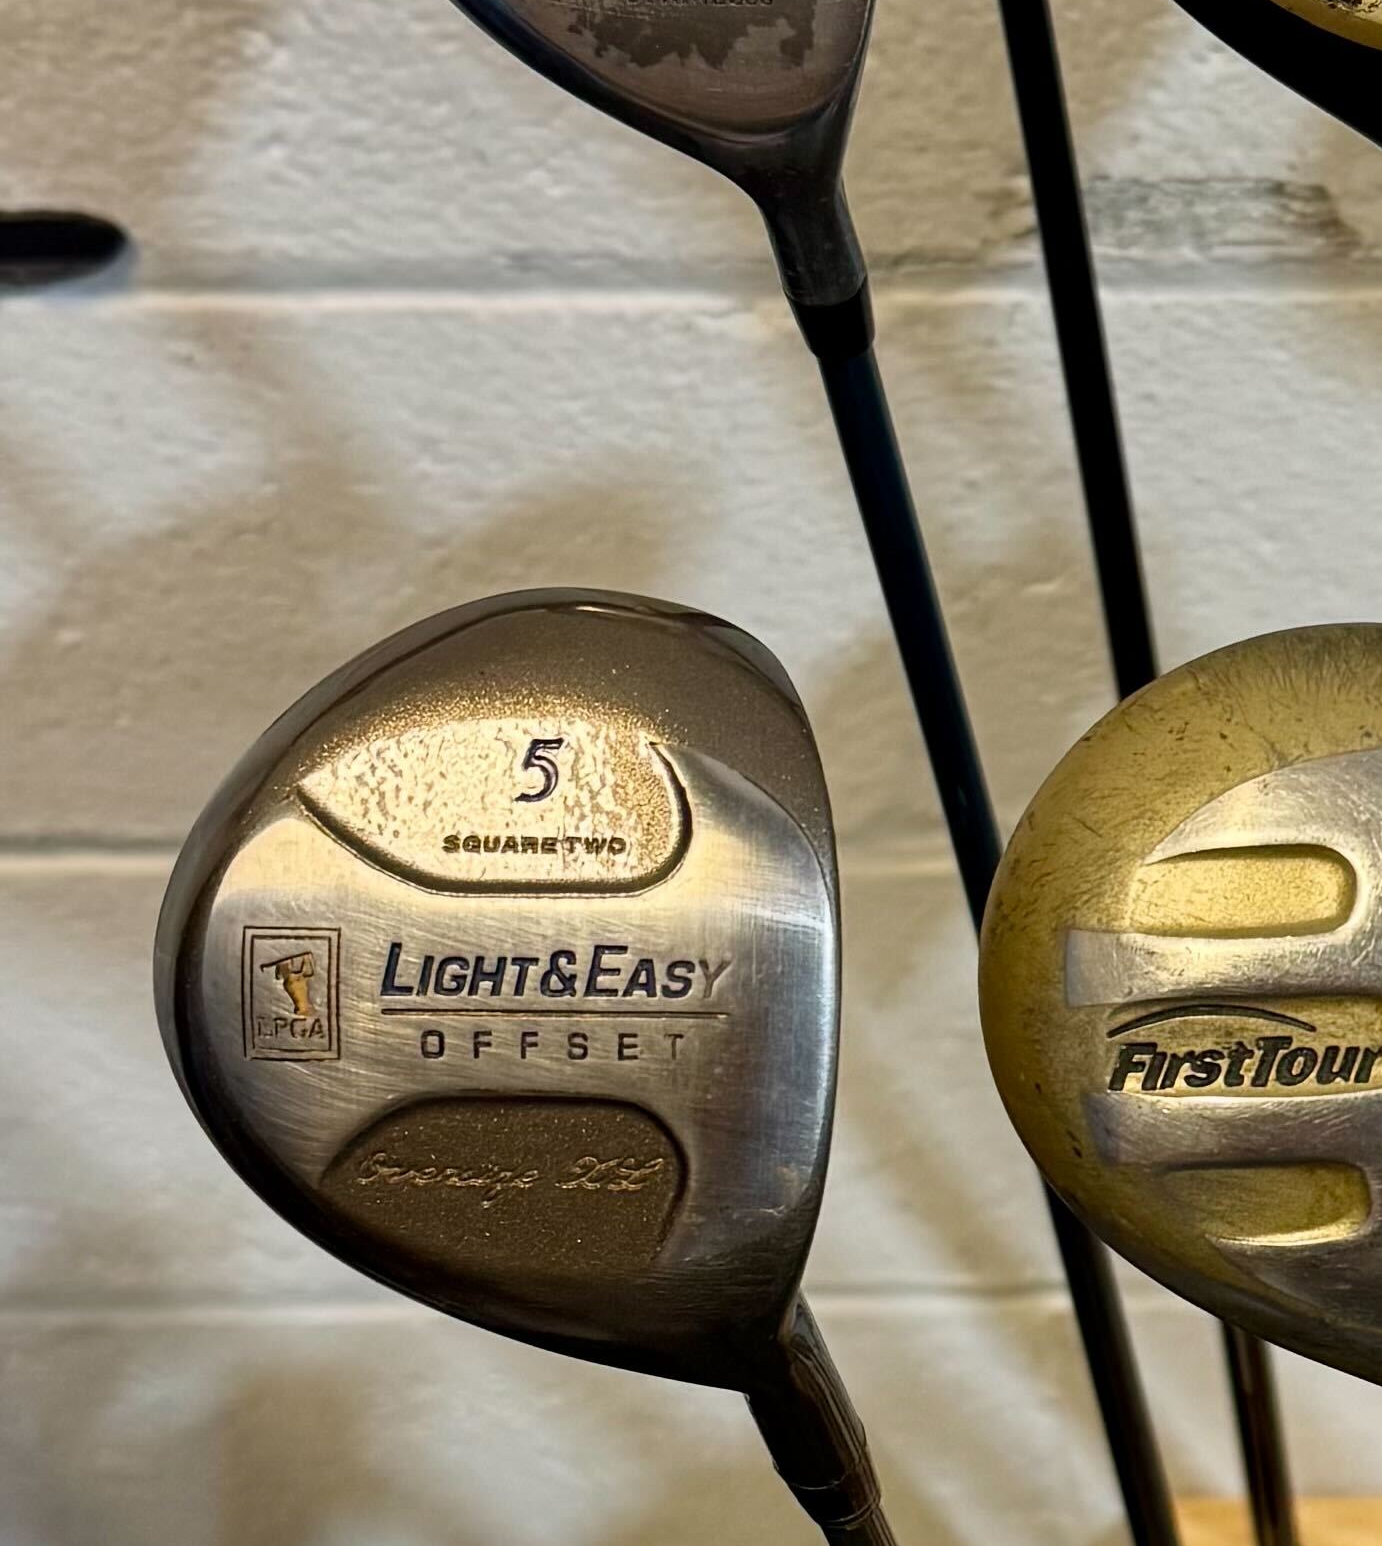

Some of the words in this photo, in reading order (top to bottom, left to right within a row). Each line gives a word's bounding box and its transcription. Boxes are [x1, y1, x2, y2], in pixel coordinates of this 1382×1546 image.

[514, 738, 565, 803] 5
[256, 1017, 325, 1039] LPGA
[420, 1029, 685, 1061] OFFSET
